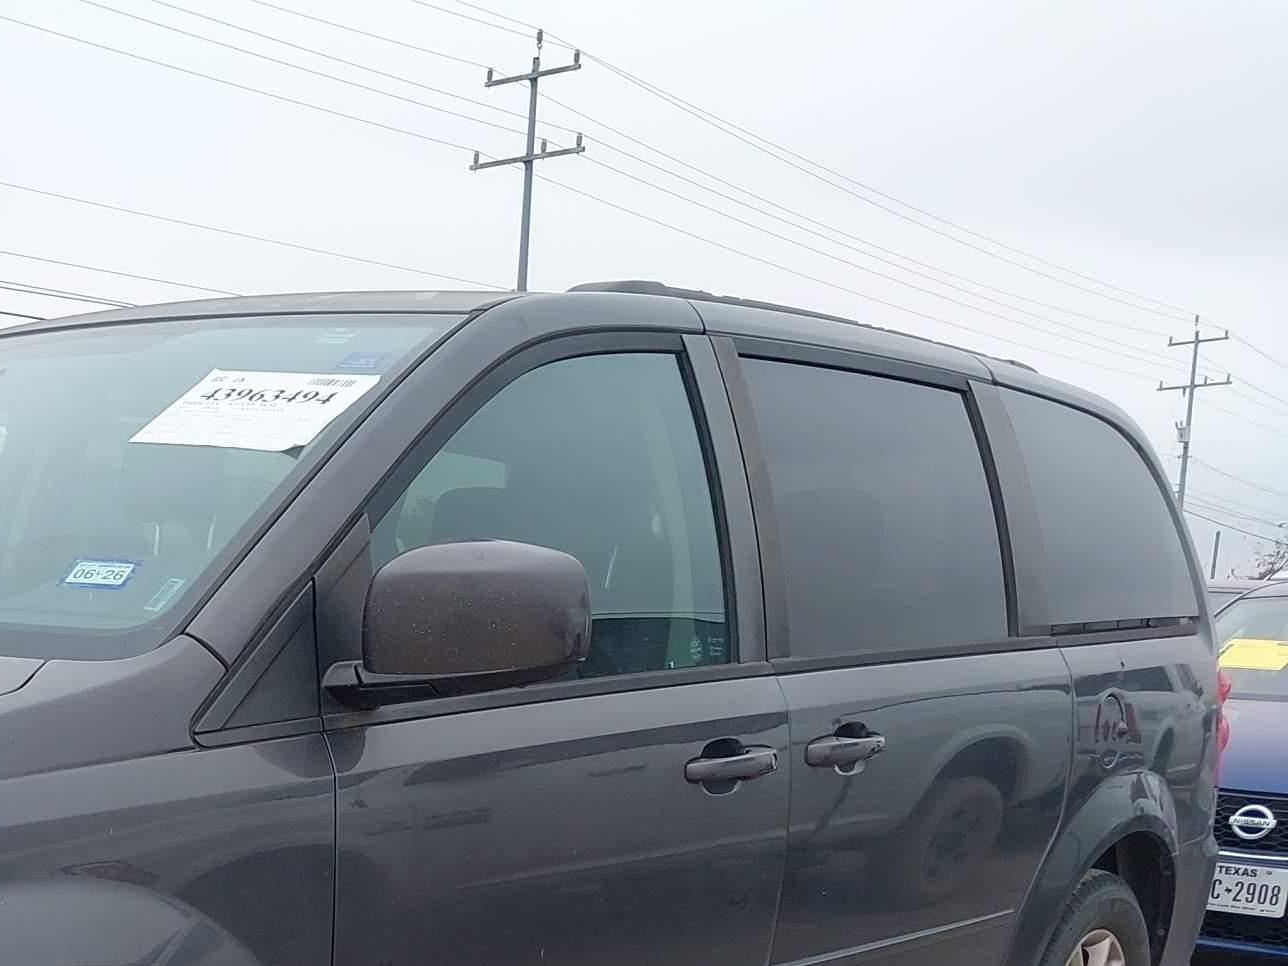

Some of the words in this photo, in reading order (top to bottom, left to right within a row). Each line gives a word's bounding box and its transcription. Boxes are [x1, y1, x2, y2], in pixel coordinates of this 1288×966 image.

[201, 387, 338, 405] 43963494
[1232, 817, 1272, 827] NISSAN
[1217, 864, 1258, 879] TEXAS
